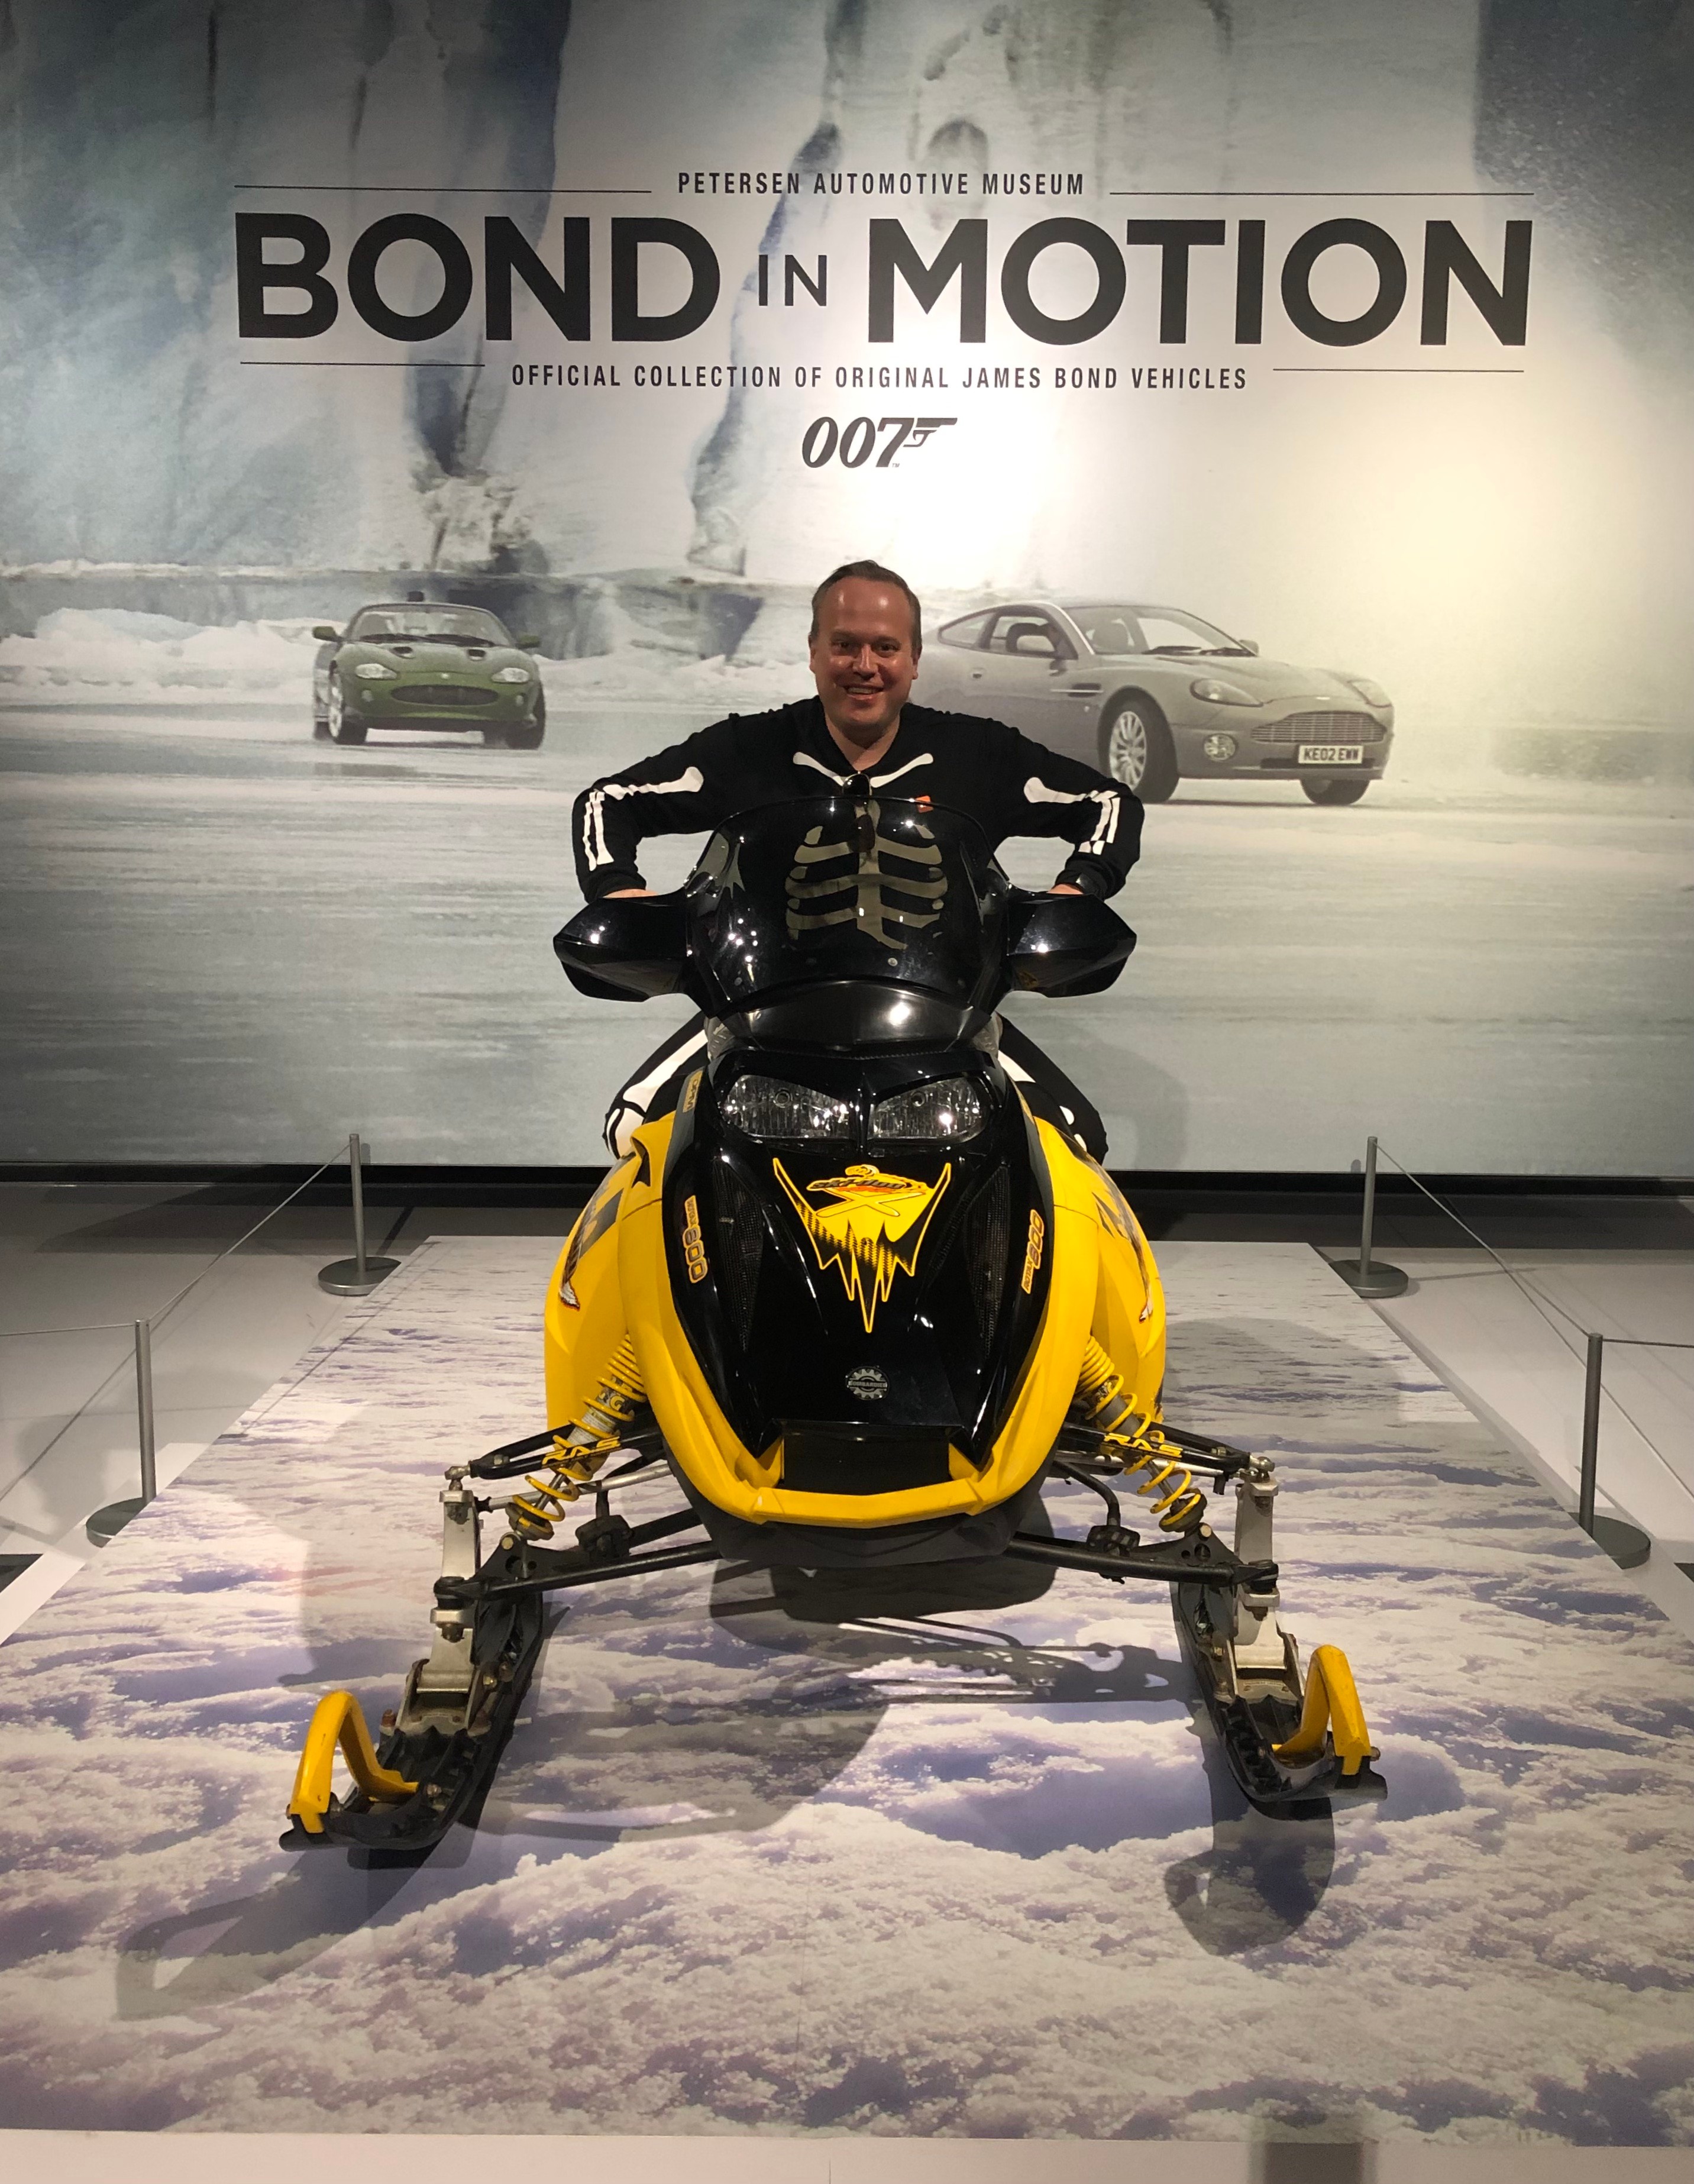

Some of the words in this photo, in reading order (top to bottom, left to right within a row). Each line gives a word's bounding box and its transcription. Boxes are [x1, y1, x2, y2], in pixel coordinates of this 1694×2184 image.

[678, 172, 799, 194] PETERSEN
[813, 173, 968, 194] AUTOMOTIVE
[983, 173, 1082, 195] MUSEUM
[235, 212, 720, 342] BOND
[758, 254, 827, 306] IN
[869, 217, 1533, 347] MOTION
[512, 364, 620, 386] OFFICIAL
[634, 365, 780, 387] COLLECTION
[796, 367, 822, 387] OF
[836, 367, 948, 388] ORIGINAL
[963, 367, 1040, 388] JAMES
[1055, 367, 1117, 389] BOND
[1132, 368, 1246, 389] VEHICLES
[801, 416, 915, 469] 007
[1303, 747, 1336, 761] KE02
